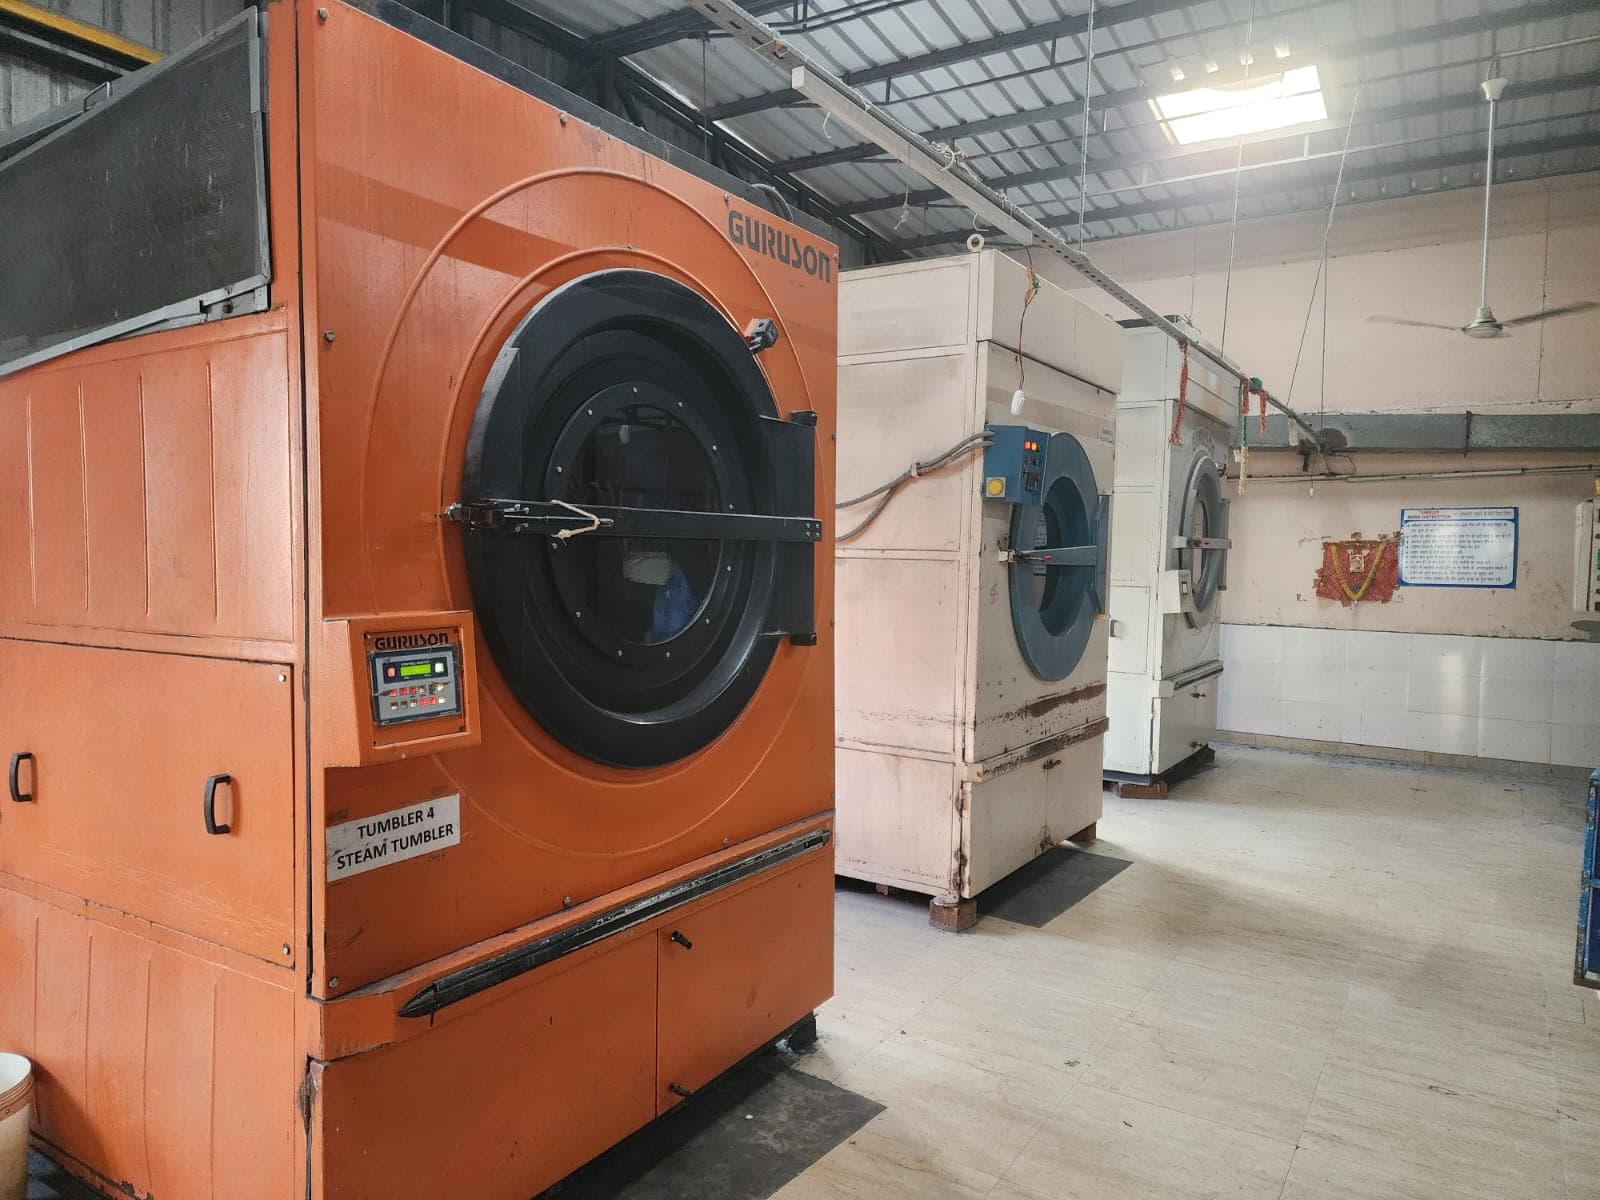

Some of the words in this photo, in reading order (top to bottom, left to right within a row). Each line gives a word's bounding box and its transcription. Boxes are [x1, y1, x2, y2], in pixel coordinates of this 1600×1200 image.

[728, 210, 831, 283] GURUSON
[375, 633, 449, 650] GURUSON
[357, 810, 424, 839] TUMBLER
[427, 806, 435, 820] 4
[337, 843, 387, 870] STEAM
[391, 823, 454, 853] TUMBLER
